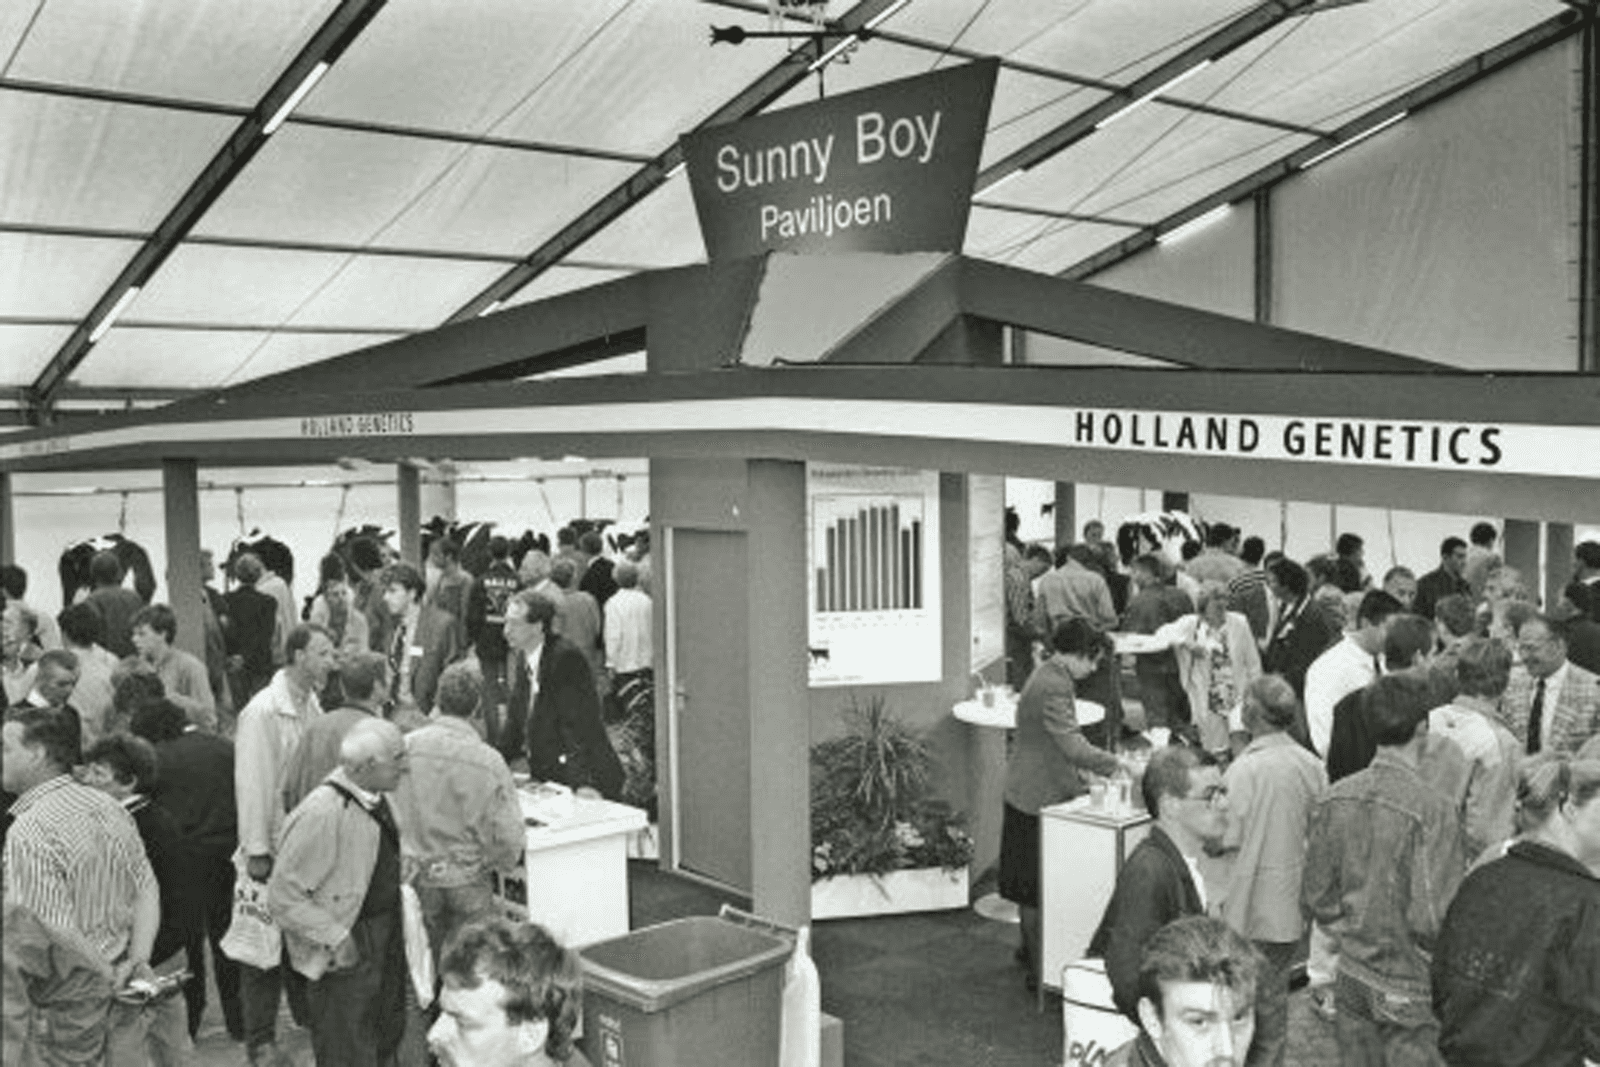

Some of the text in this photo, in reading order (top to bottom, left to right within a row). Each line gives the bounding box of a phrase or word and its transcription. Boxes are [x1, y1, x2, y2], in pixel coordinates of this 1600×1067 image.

[717, 111, 941, 192] Sunny Boy
[761, 194, 892, 242] Paviljoen
[1075, 411, 1502, 466] HOLLAND GENETICS
